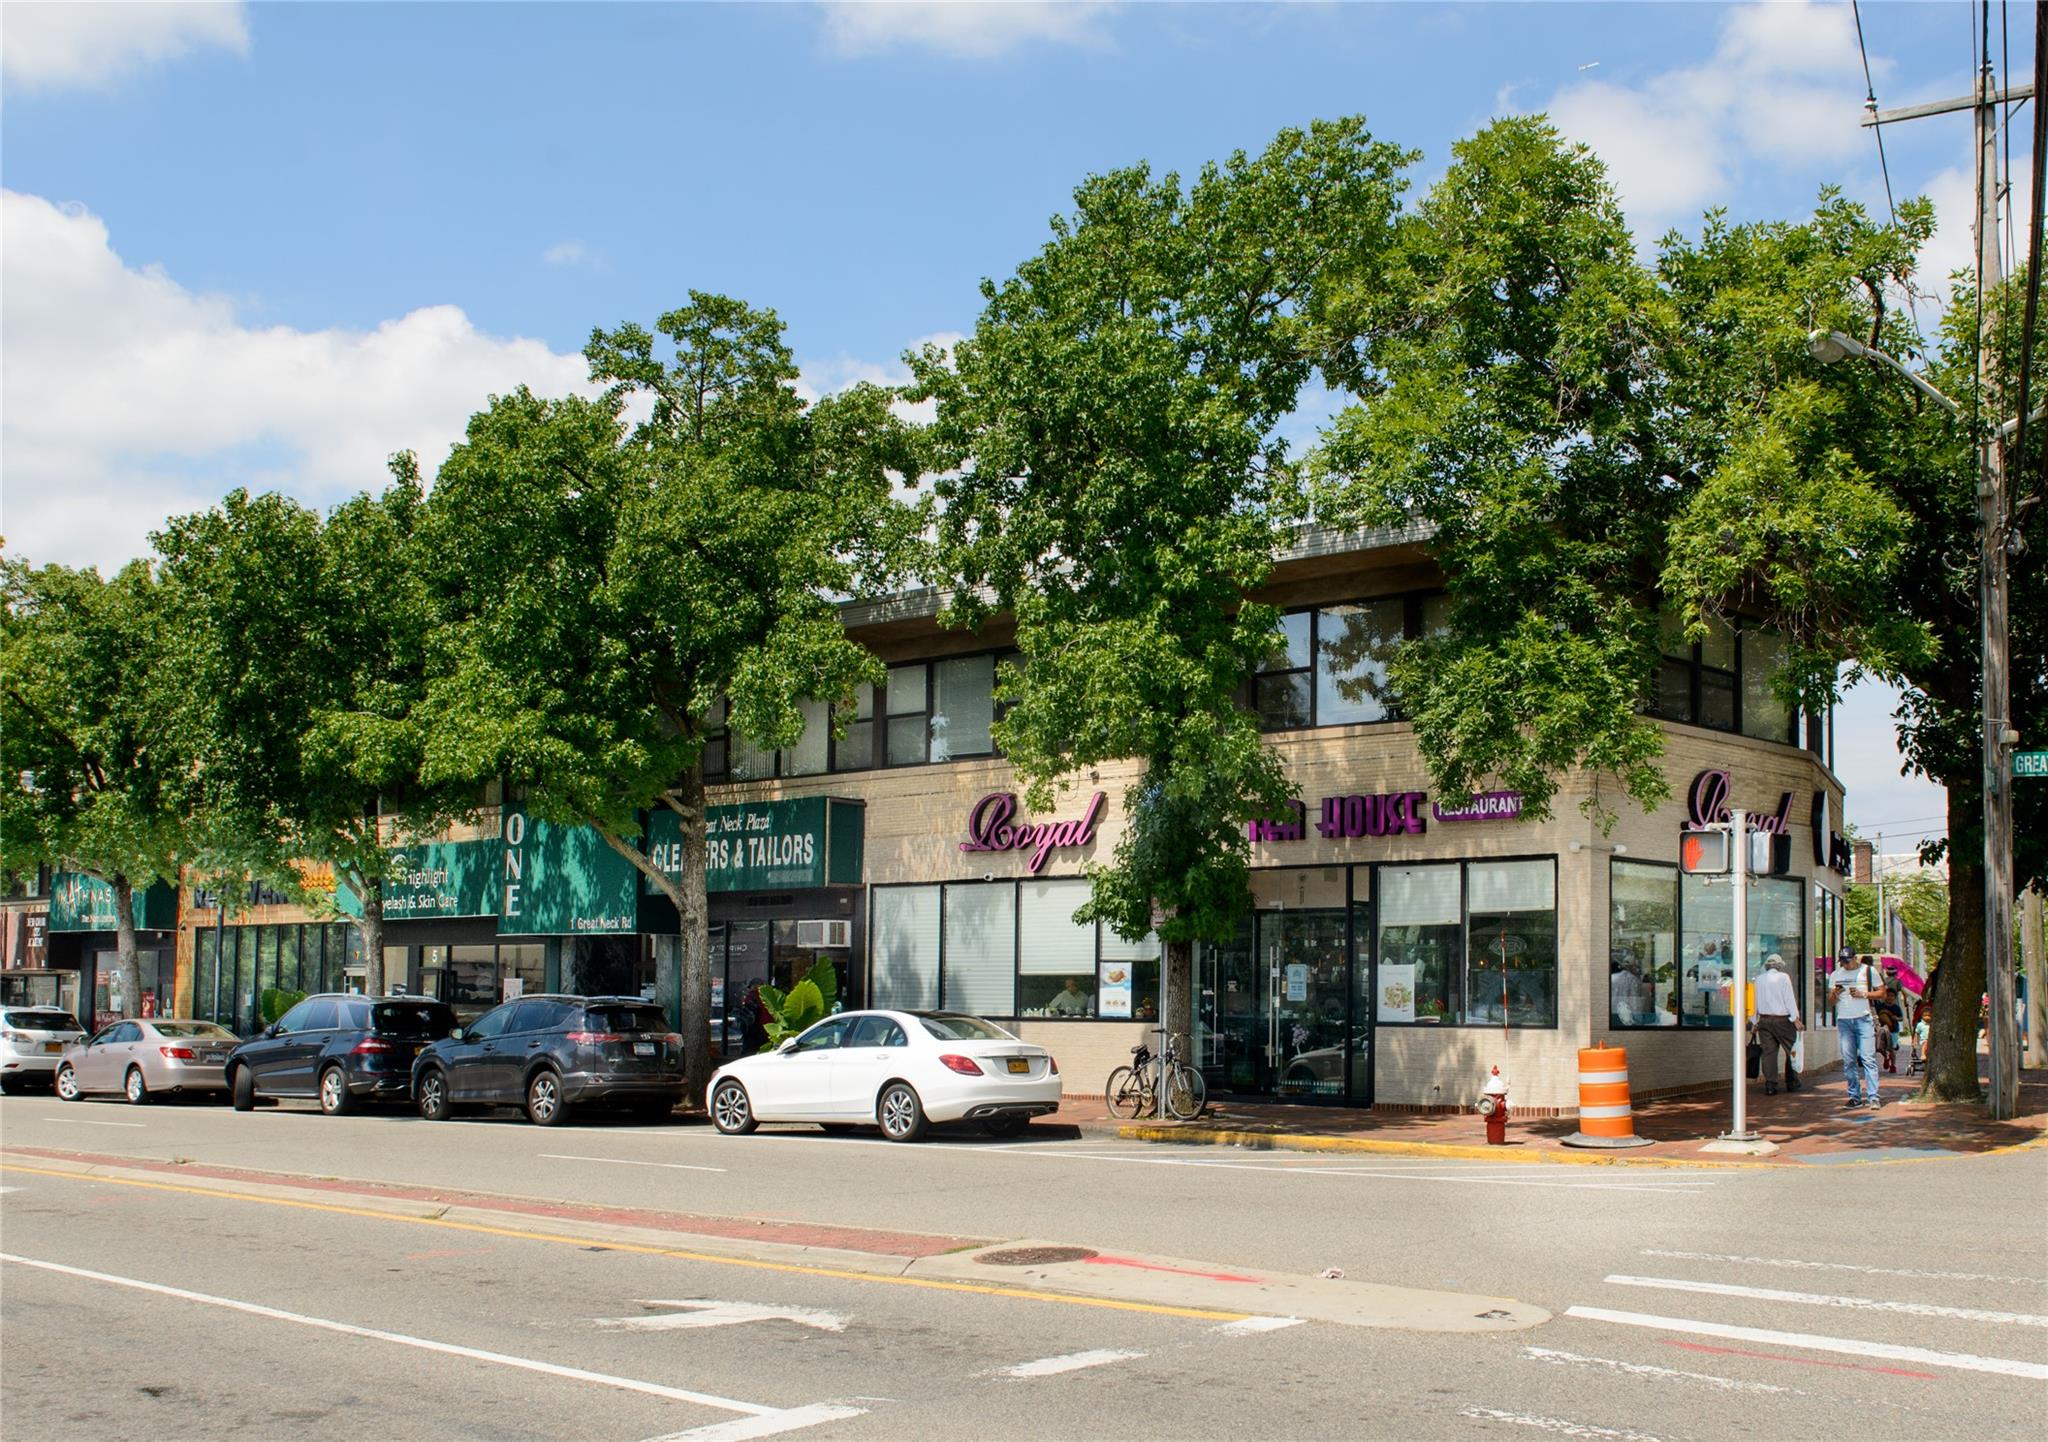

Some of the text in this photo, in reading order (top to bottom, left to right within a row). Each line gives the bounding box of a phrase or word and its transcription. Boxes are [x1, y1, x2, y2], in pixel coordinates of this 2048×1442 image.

[2015, 754, 2048, 773] GREA
[1315, 792, 1427, 838] HOUSE
[1682, 769, 1796, 835] Ryal
[720, 815, 743, 833] Neck
[745, 813, 770, 831] Plaza
[959, 791, 1107, 873] Royal
[504, 812, 525, 917] ONE
[734, 838, 744, 869] &
[748, 832, 814, 867] TAILORS
[418, 894, 436, 909] Skin
[438, 893, 458, 909] Care
[577, 917, 599, 930] Great
[600, 917, 620, 929] Neck
[621, 916, 633, 929] Rd
[431, 949, 438, 963] 5
